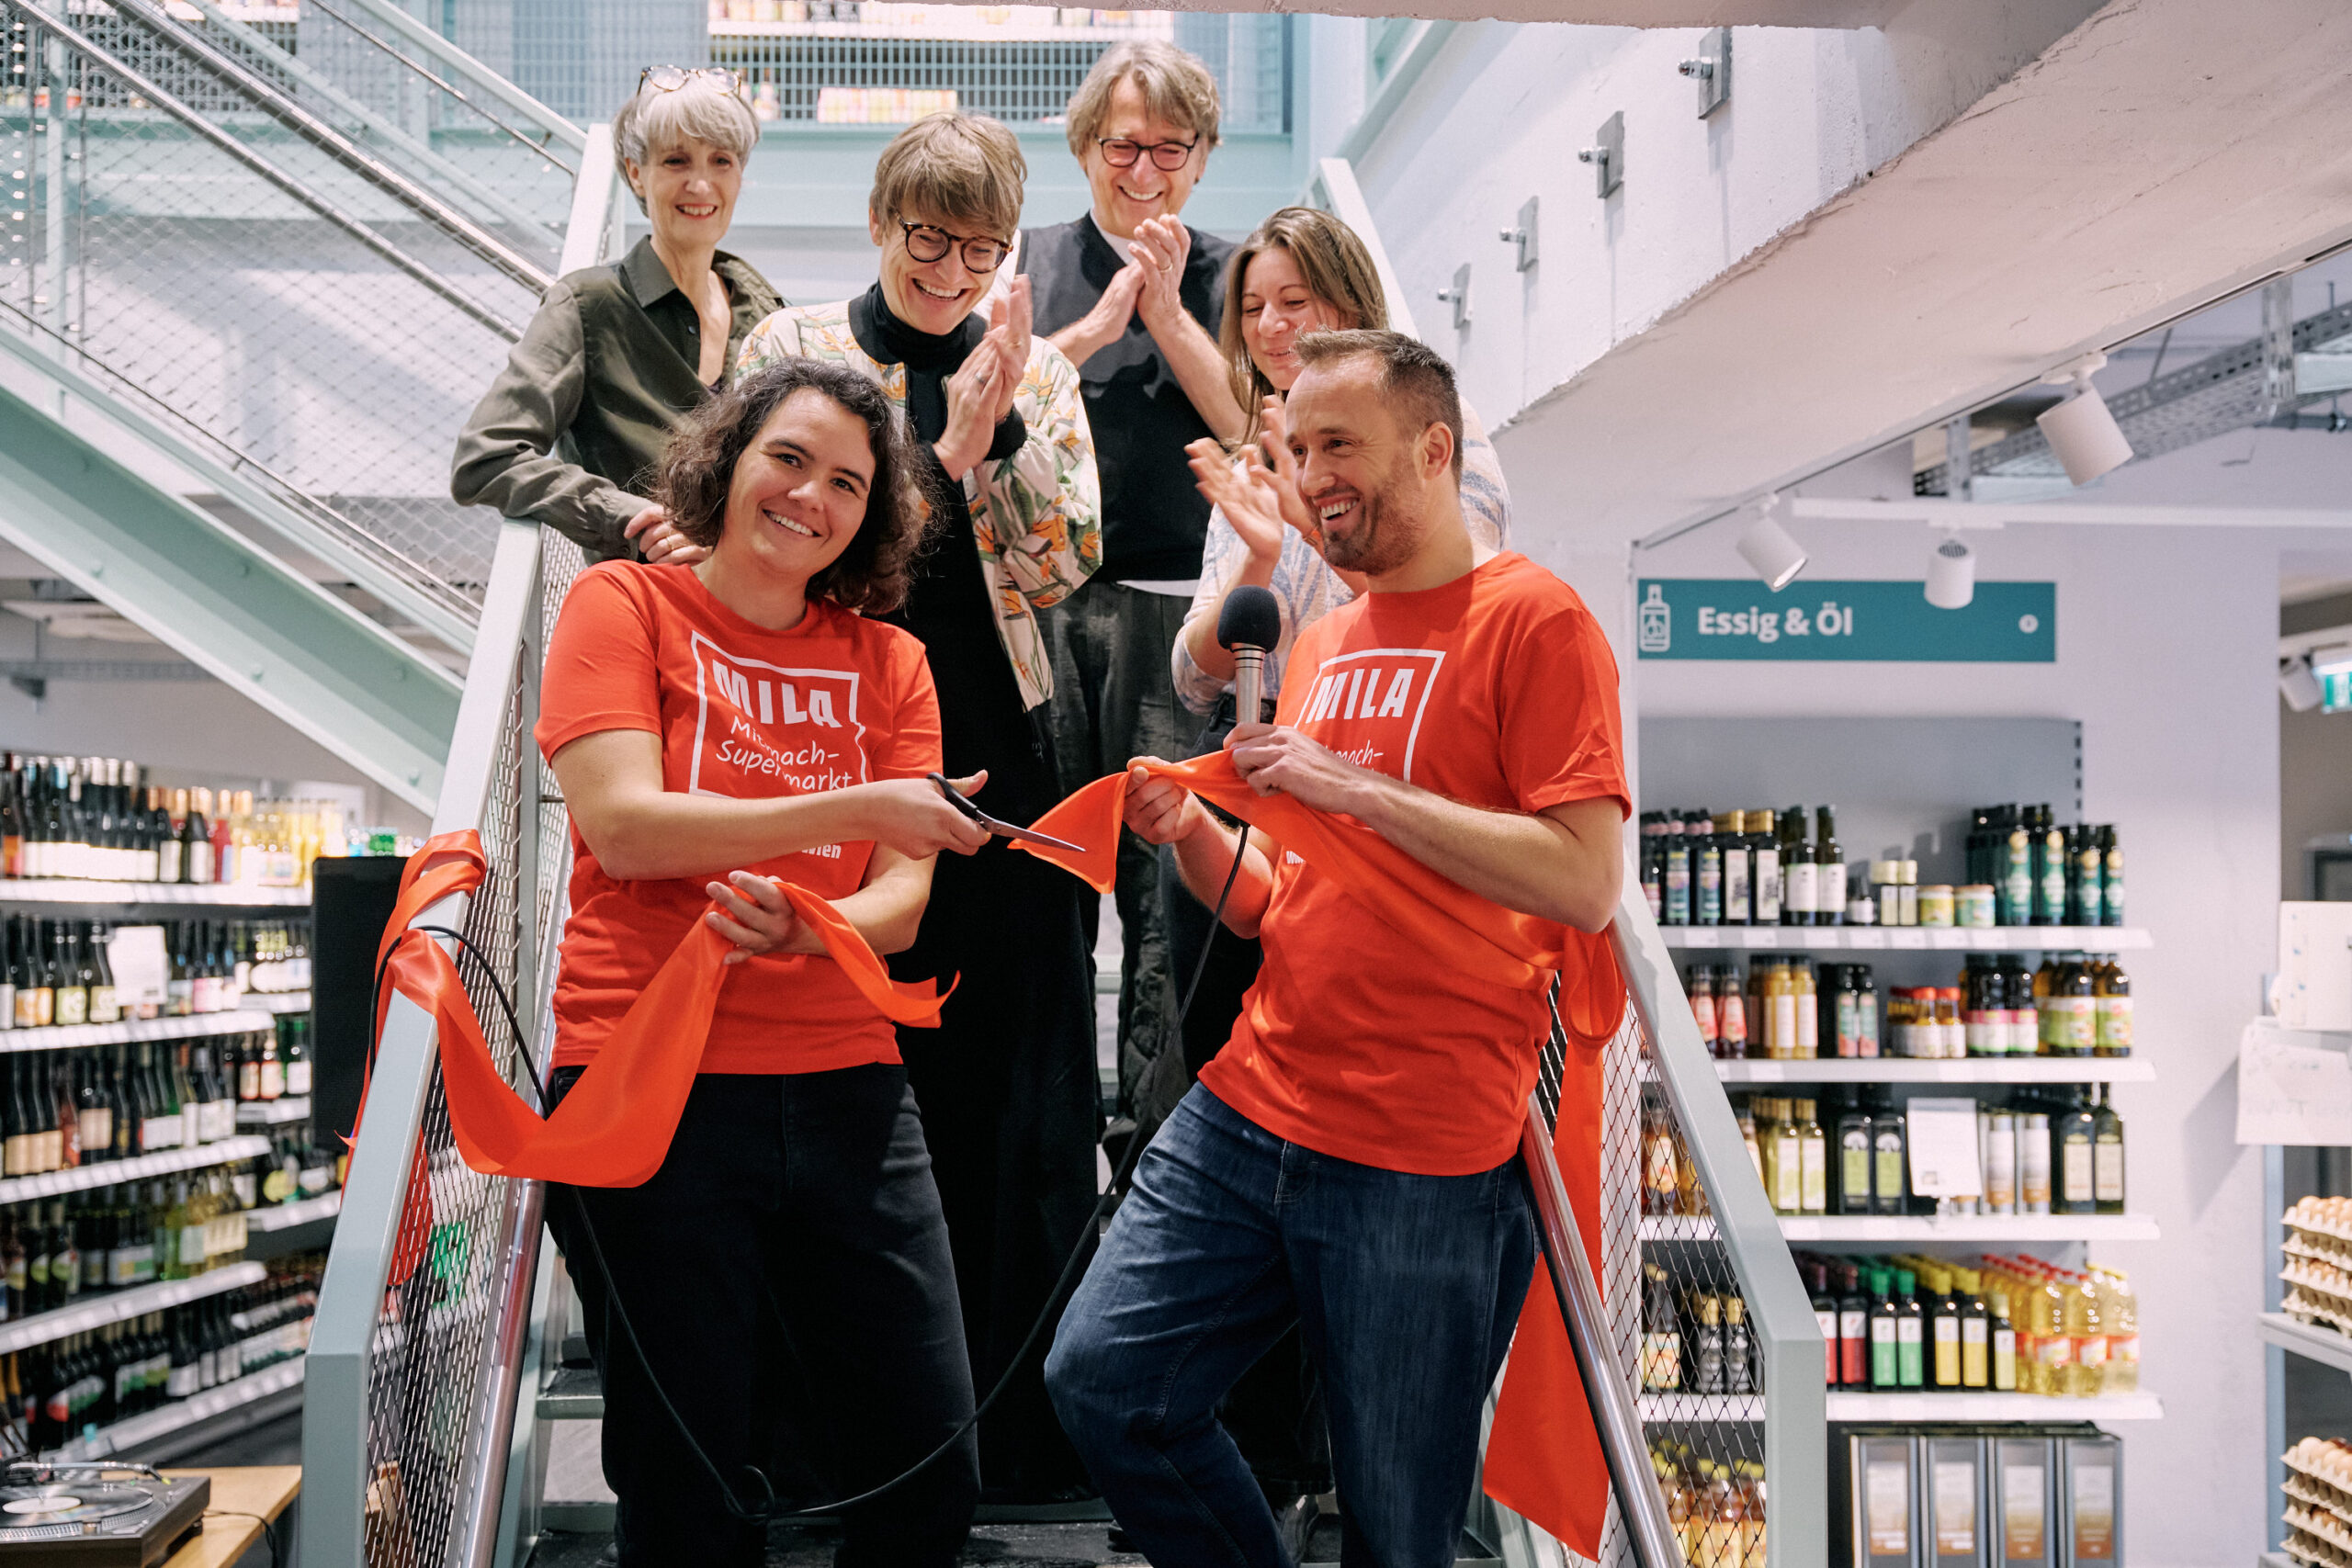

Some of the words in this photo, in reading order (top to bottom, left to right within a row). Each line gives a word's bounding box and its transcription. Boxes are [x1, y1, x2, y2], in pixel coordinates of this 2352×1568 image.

[1698, 606, 1780, 642] Essig
[1784, 608, 1810, 636] &
[1816, 602, 1853, 636] Öl
[712, 659, 842, 728] MILA
[1306, 669, 1415, 724] MILA
[716, 739, 853, 791] Supermarkt
